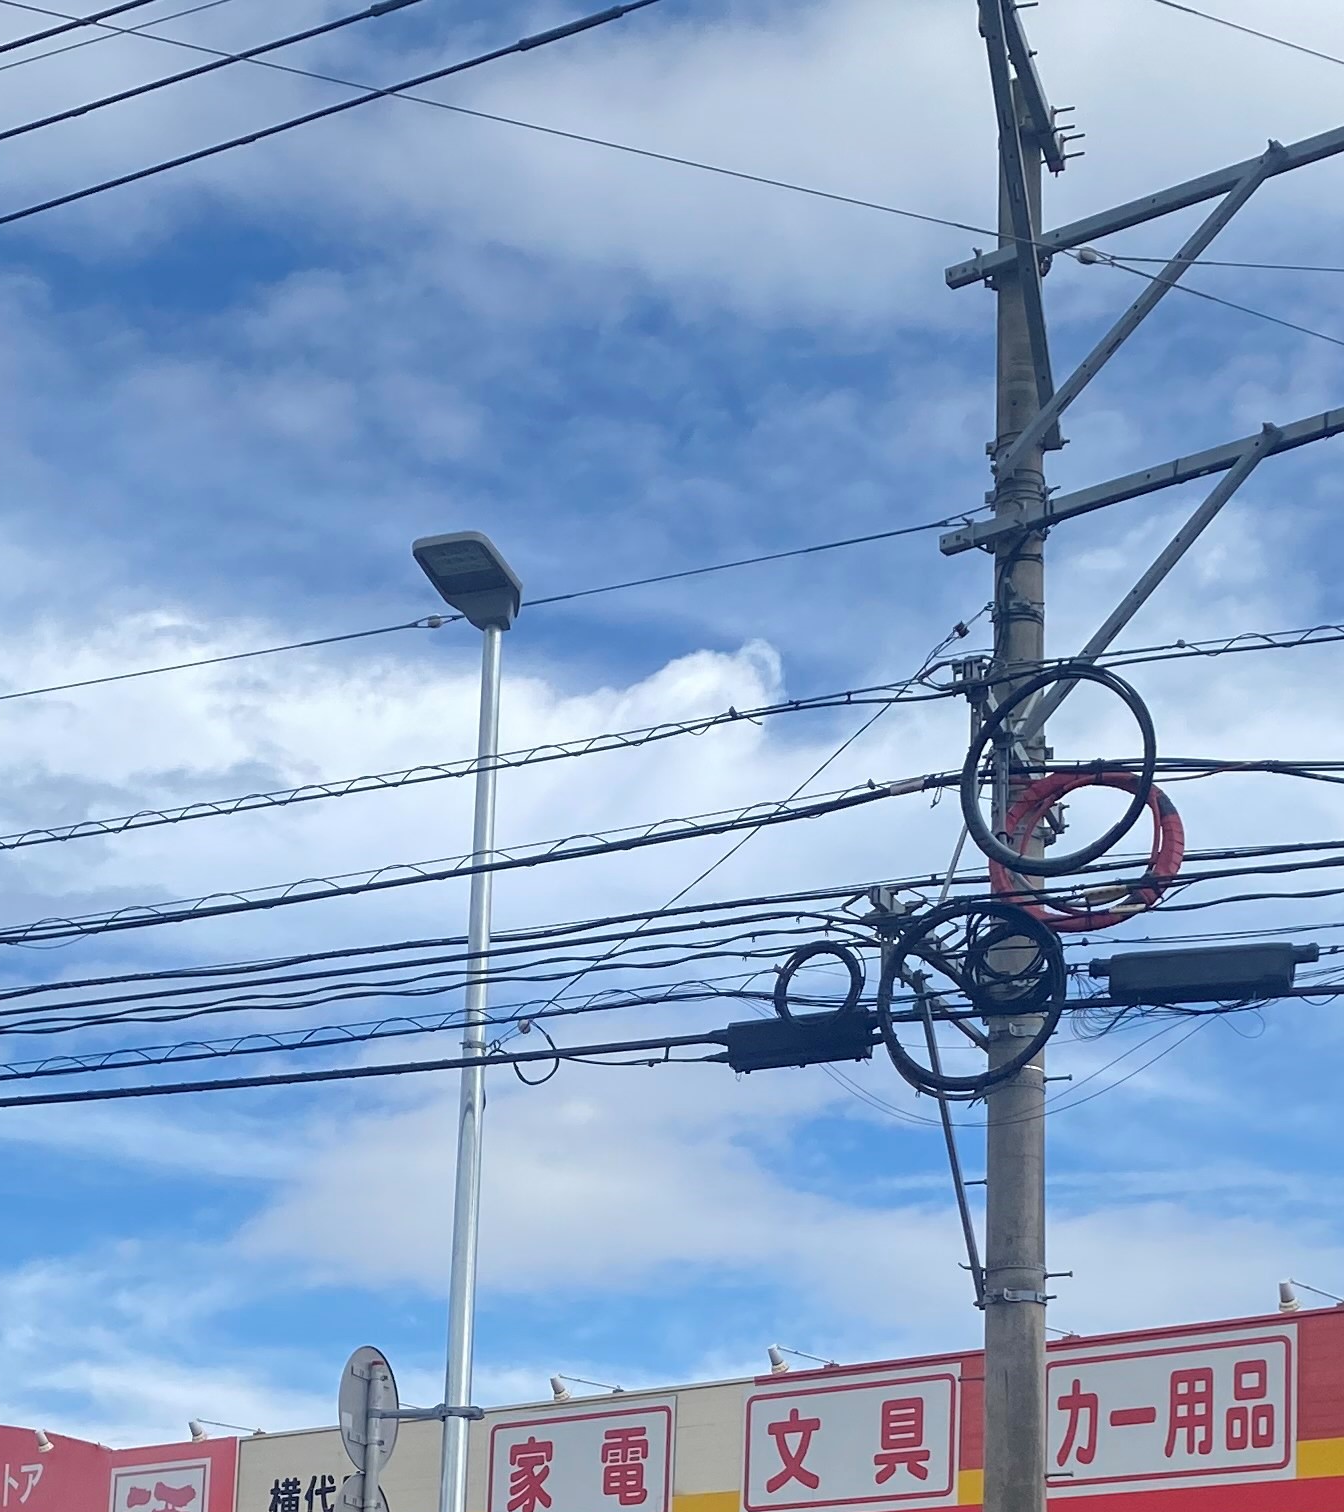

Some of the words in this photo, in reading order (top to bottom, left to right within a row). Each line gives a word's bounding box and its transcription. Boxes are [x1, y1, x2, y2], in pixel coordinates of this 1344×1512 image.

[765, 1395, 931, 1494] 文具
[1056, 1358, 1275, 1467] カー用品
